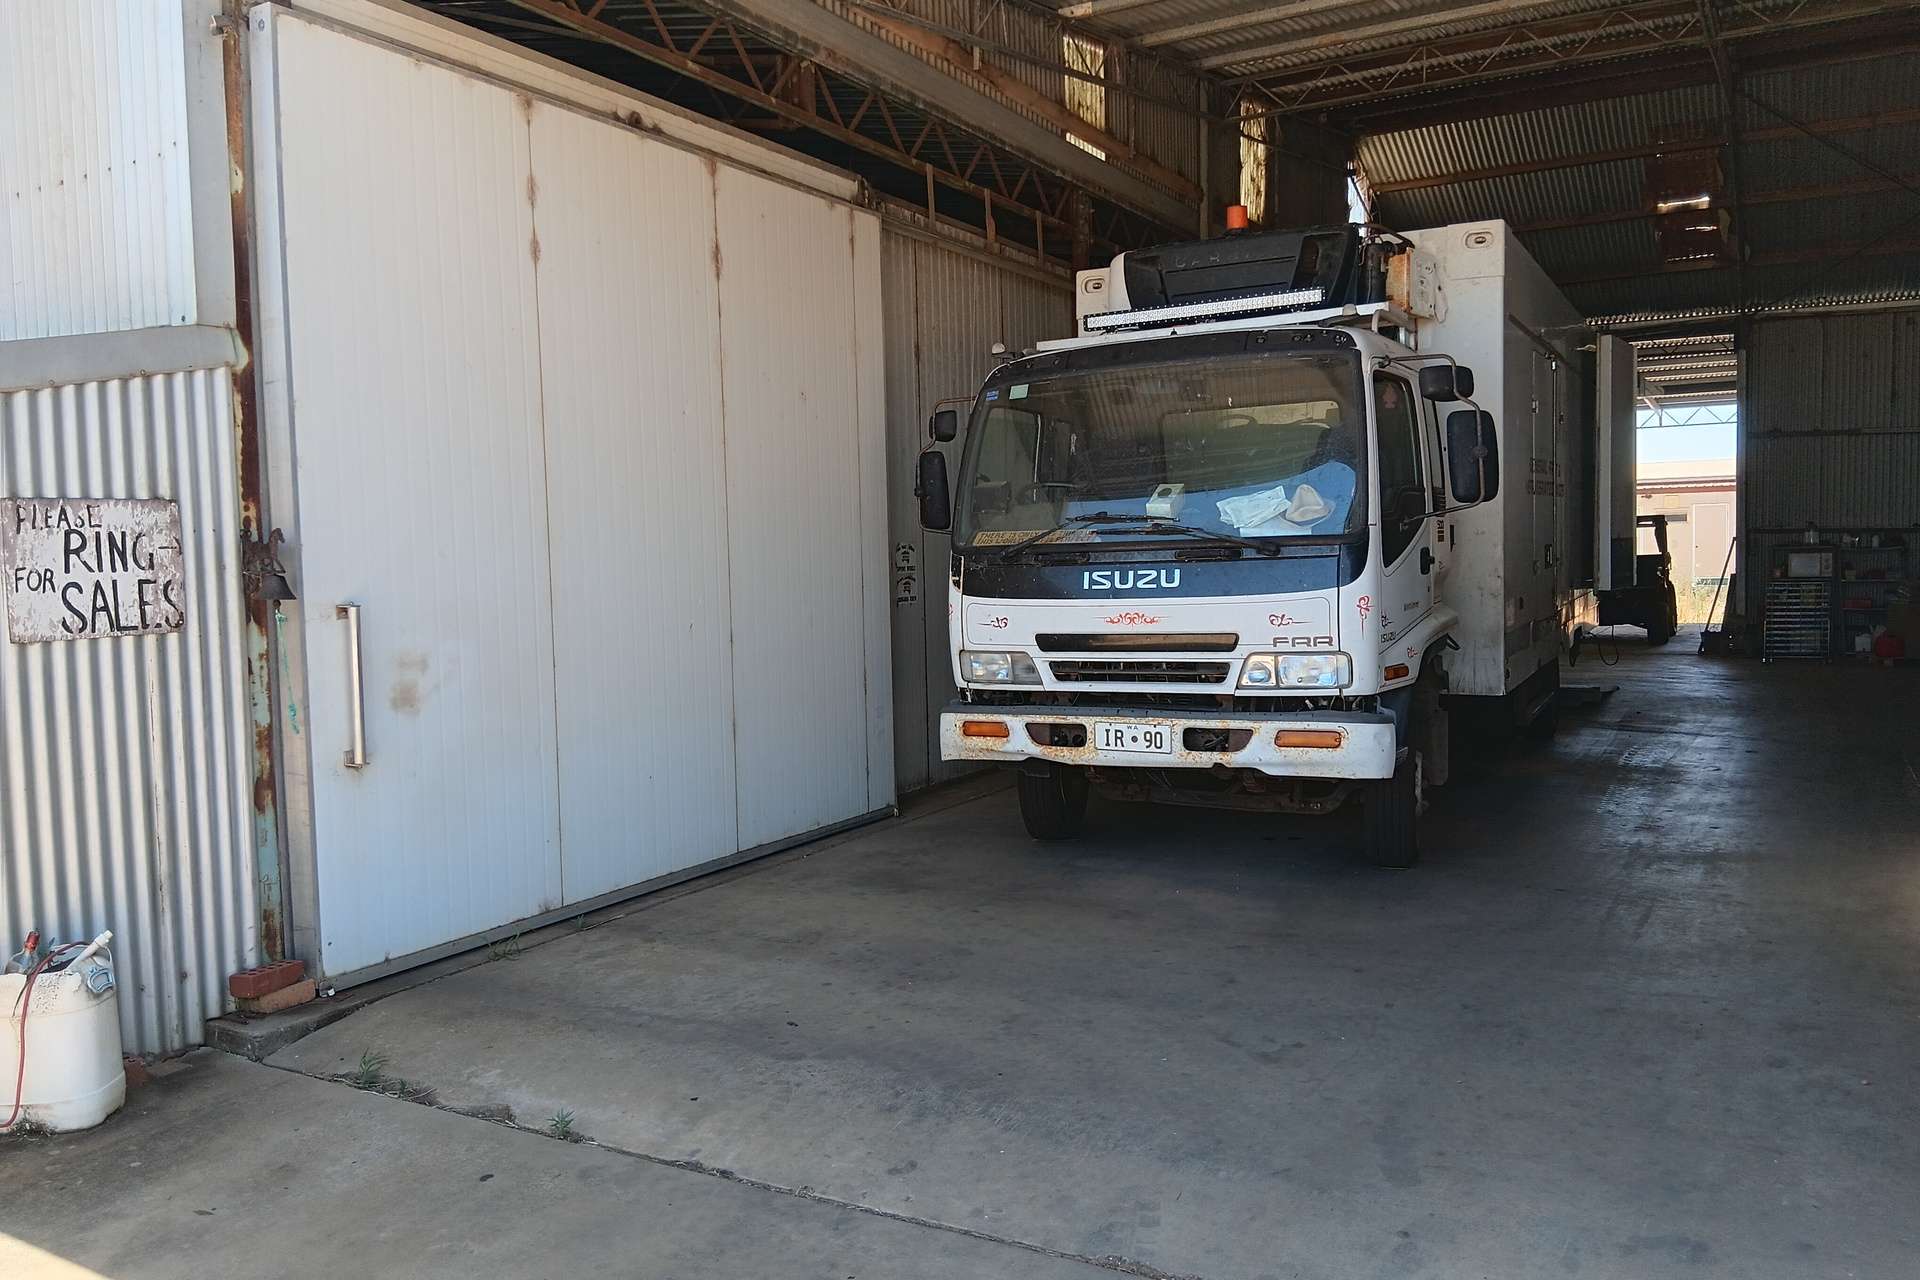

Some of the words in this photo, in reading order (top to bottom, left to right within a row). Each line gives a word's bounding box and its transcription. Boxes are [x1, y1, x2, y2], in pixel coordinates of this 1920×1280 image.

[16, 504, 102, 534] PLEASE
[63, 529, 154, 574] RING
[1083, 569, 1181, 590] ISUZU
[15, 567, 56, 593] FOR
[61, 579, 184, 634] SALES
[1273, 636, 1334, 648] FRR
[1105, 729, 1125, 748] IR
[1143, 731, 1163, 749] 90
